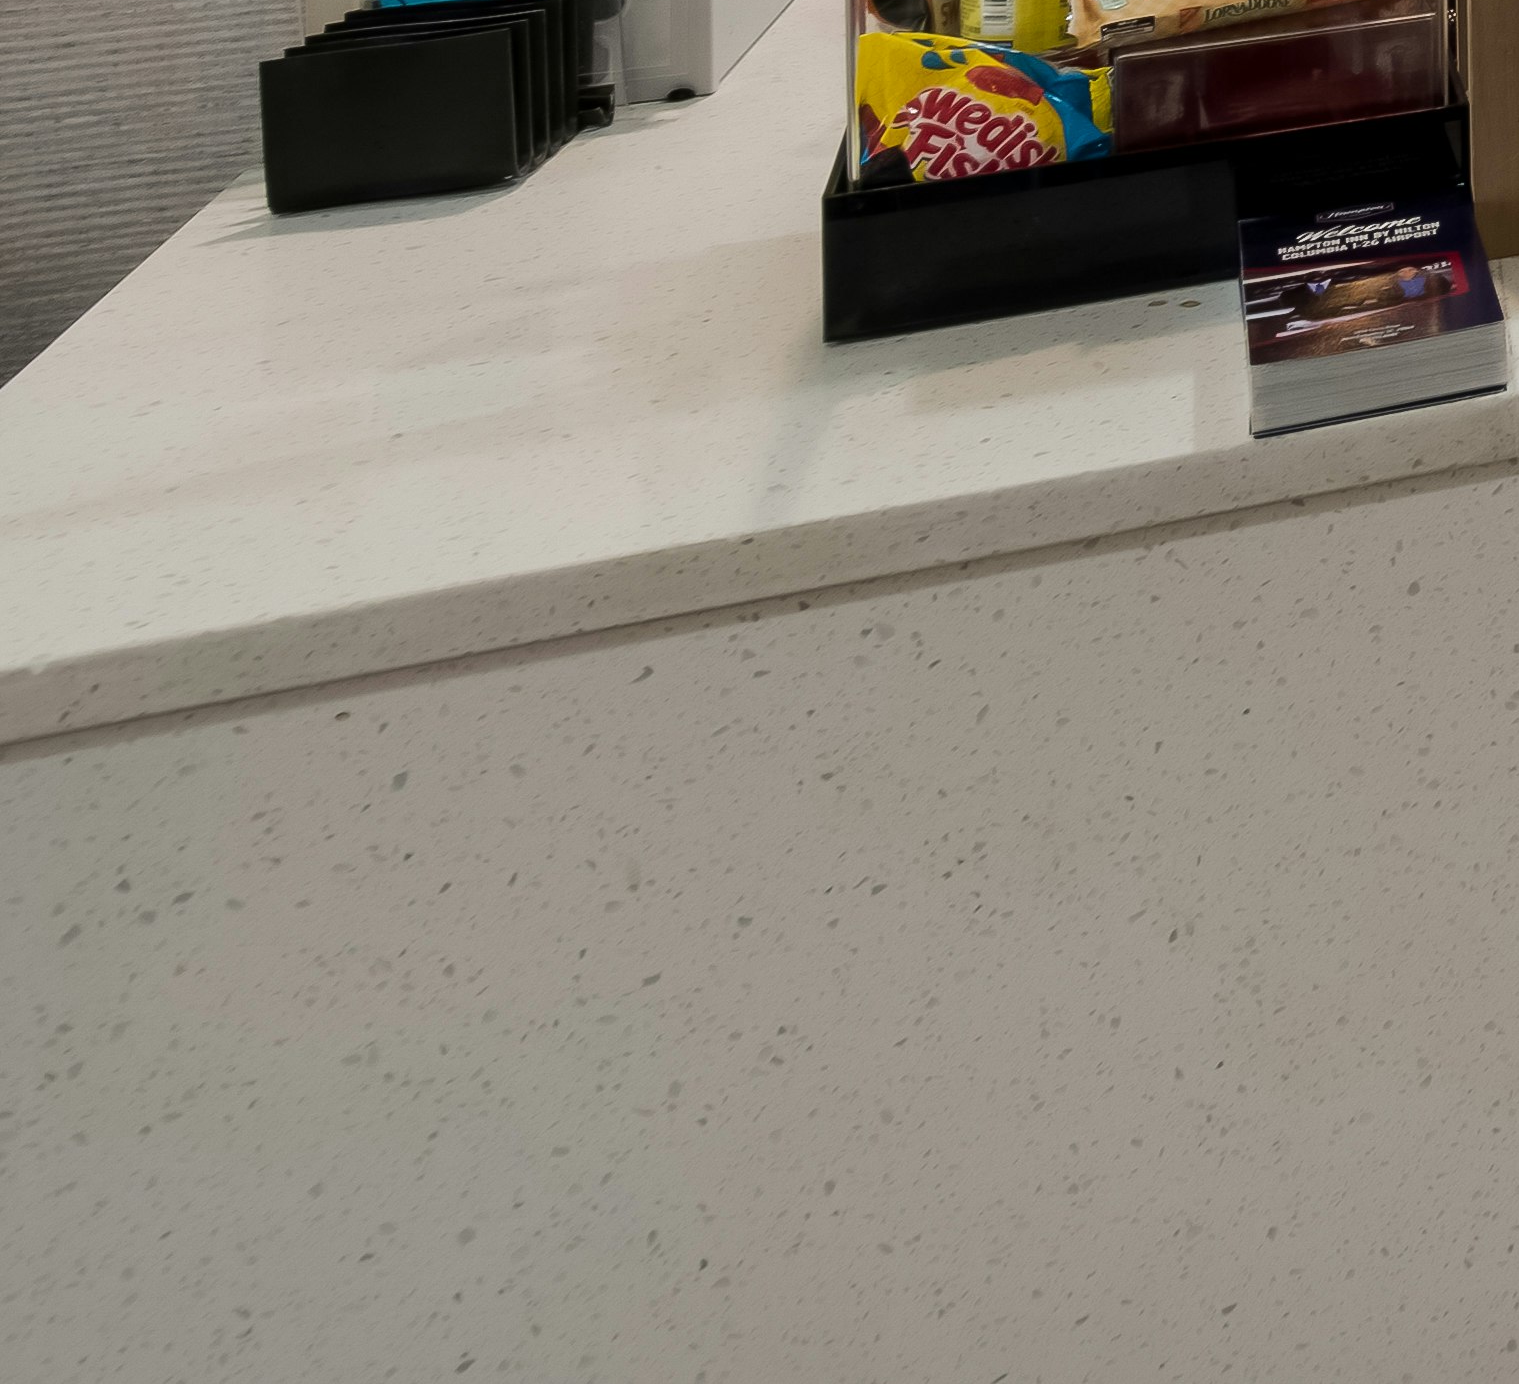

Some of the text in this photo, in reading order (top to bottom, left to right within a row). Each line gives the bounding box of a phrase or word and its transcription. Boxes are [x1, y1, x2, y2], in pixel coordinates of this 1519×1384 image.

[1277, 221, 1440, 255] HAMPTON INN BY HILTON
[1281, 245, 1348, 260] COLUMBIA
[1383, 228, 1438, 245] AIRPORT
[1296, 216, 1421, 244] Welcome
